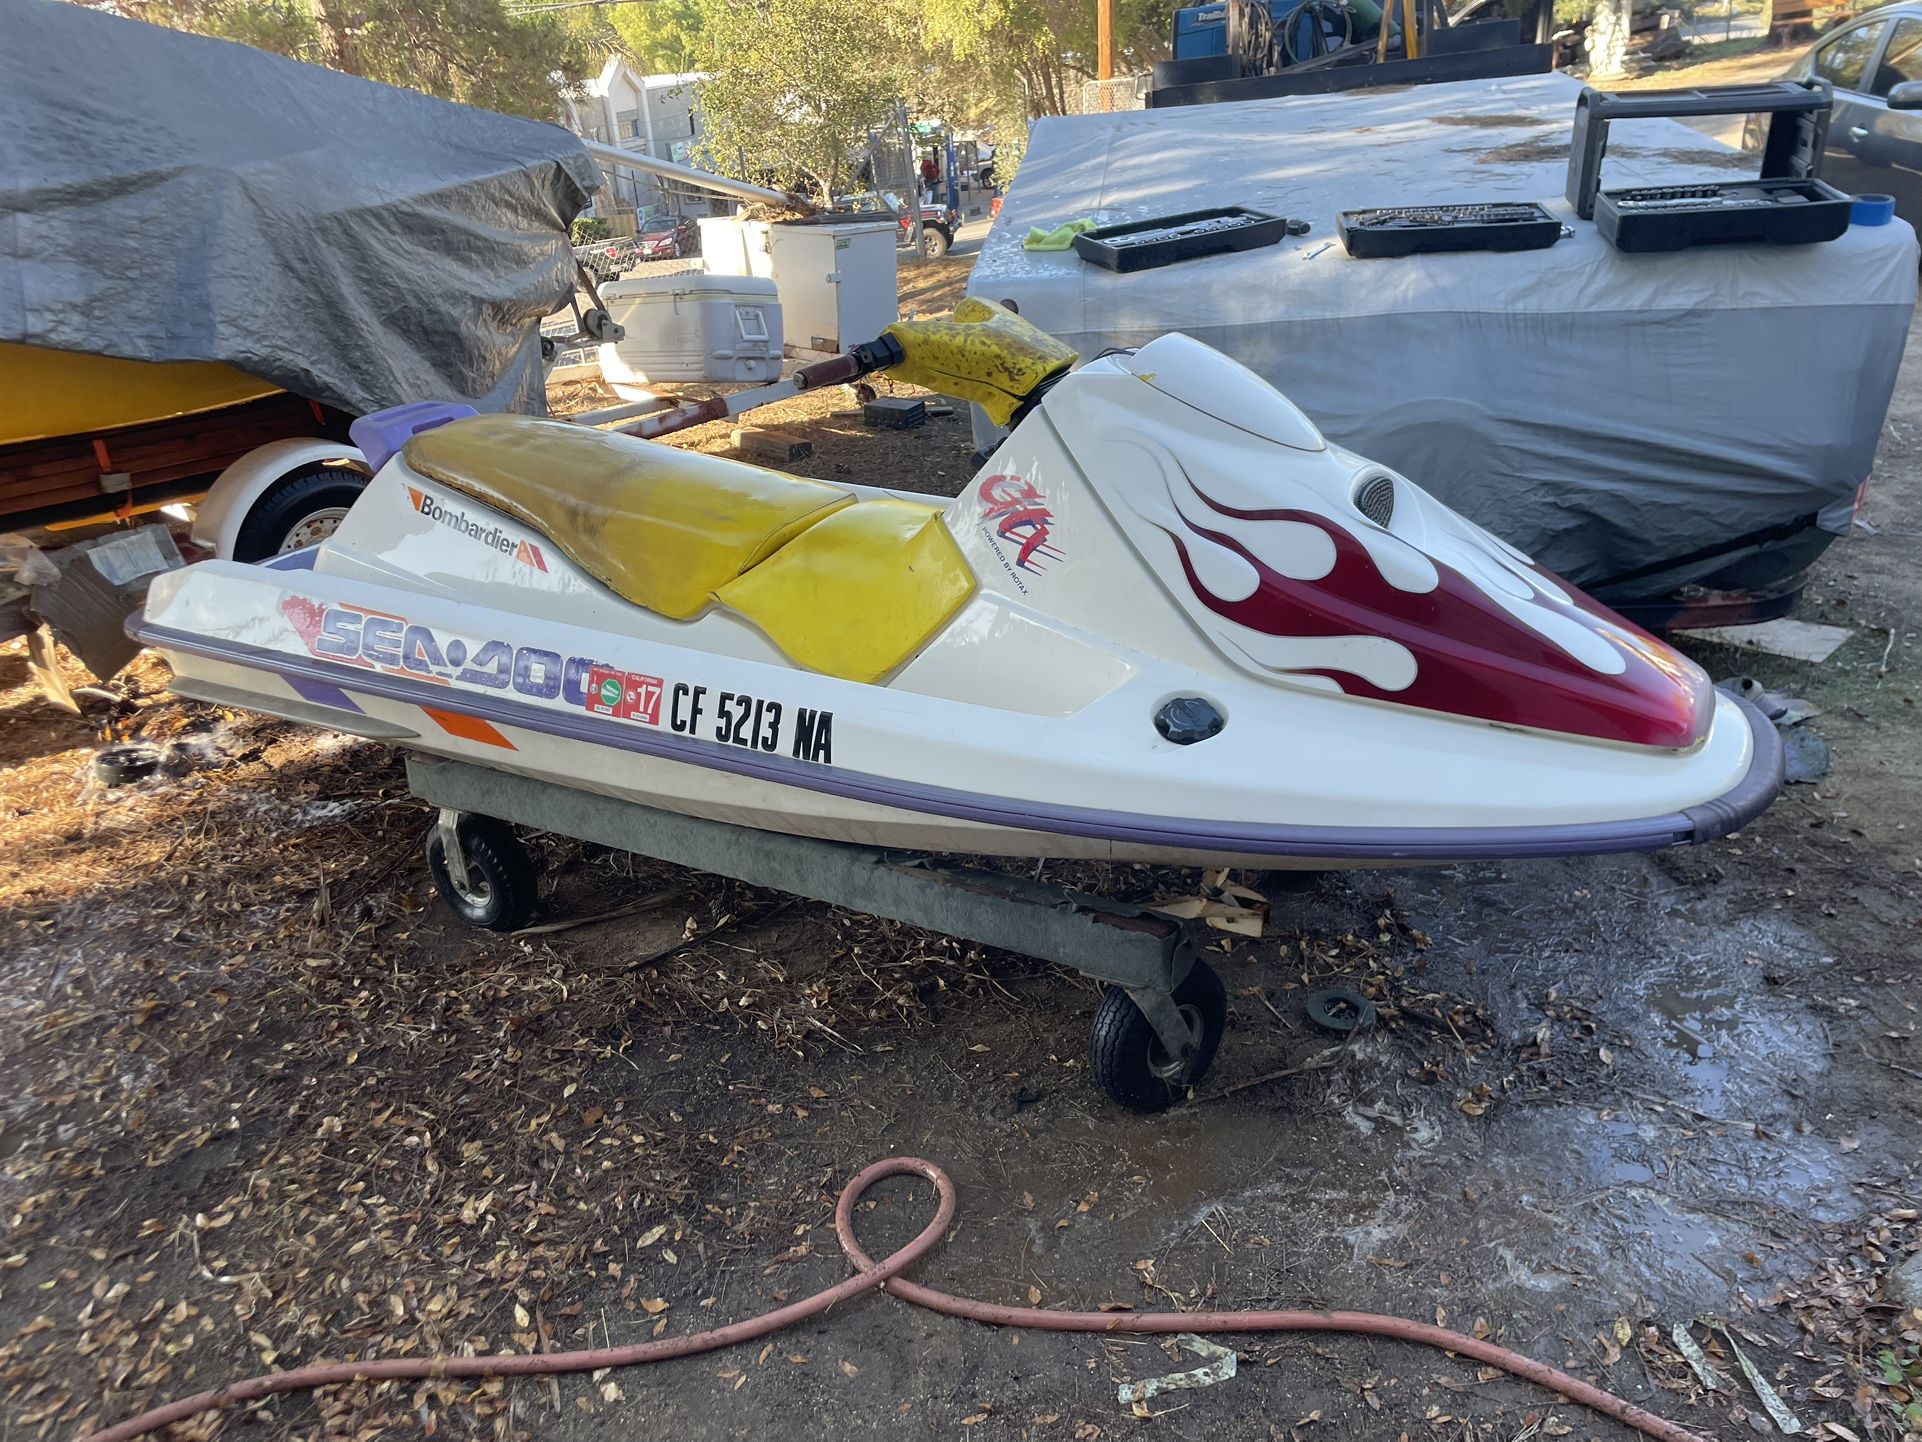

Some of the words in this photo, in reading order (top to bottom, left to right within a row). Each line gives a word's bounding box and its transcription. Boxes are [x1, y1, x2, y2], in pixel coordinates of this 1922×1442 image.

[420, 494, 518, 556] Bombardier
[982, 526, 1006, 563] POWERED
[1003, 562, 1013, 573] BY
[1010, 571, 1029, 596] ROTAX
[631, 674, 658, 684] CALIFORNIA
[637, 684, 661, 715] 17
[671, 682, 707, 735] CF
[715, 691, 782, 752] 5213
[792, 707, 833, 764] NA
